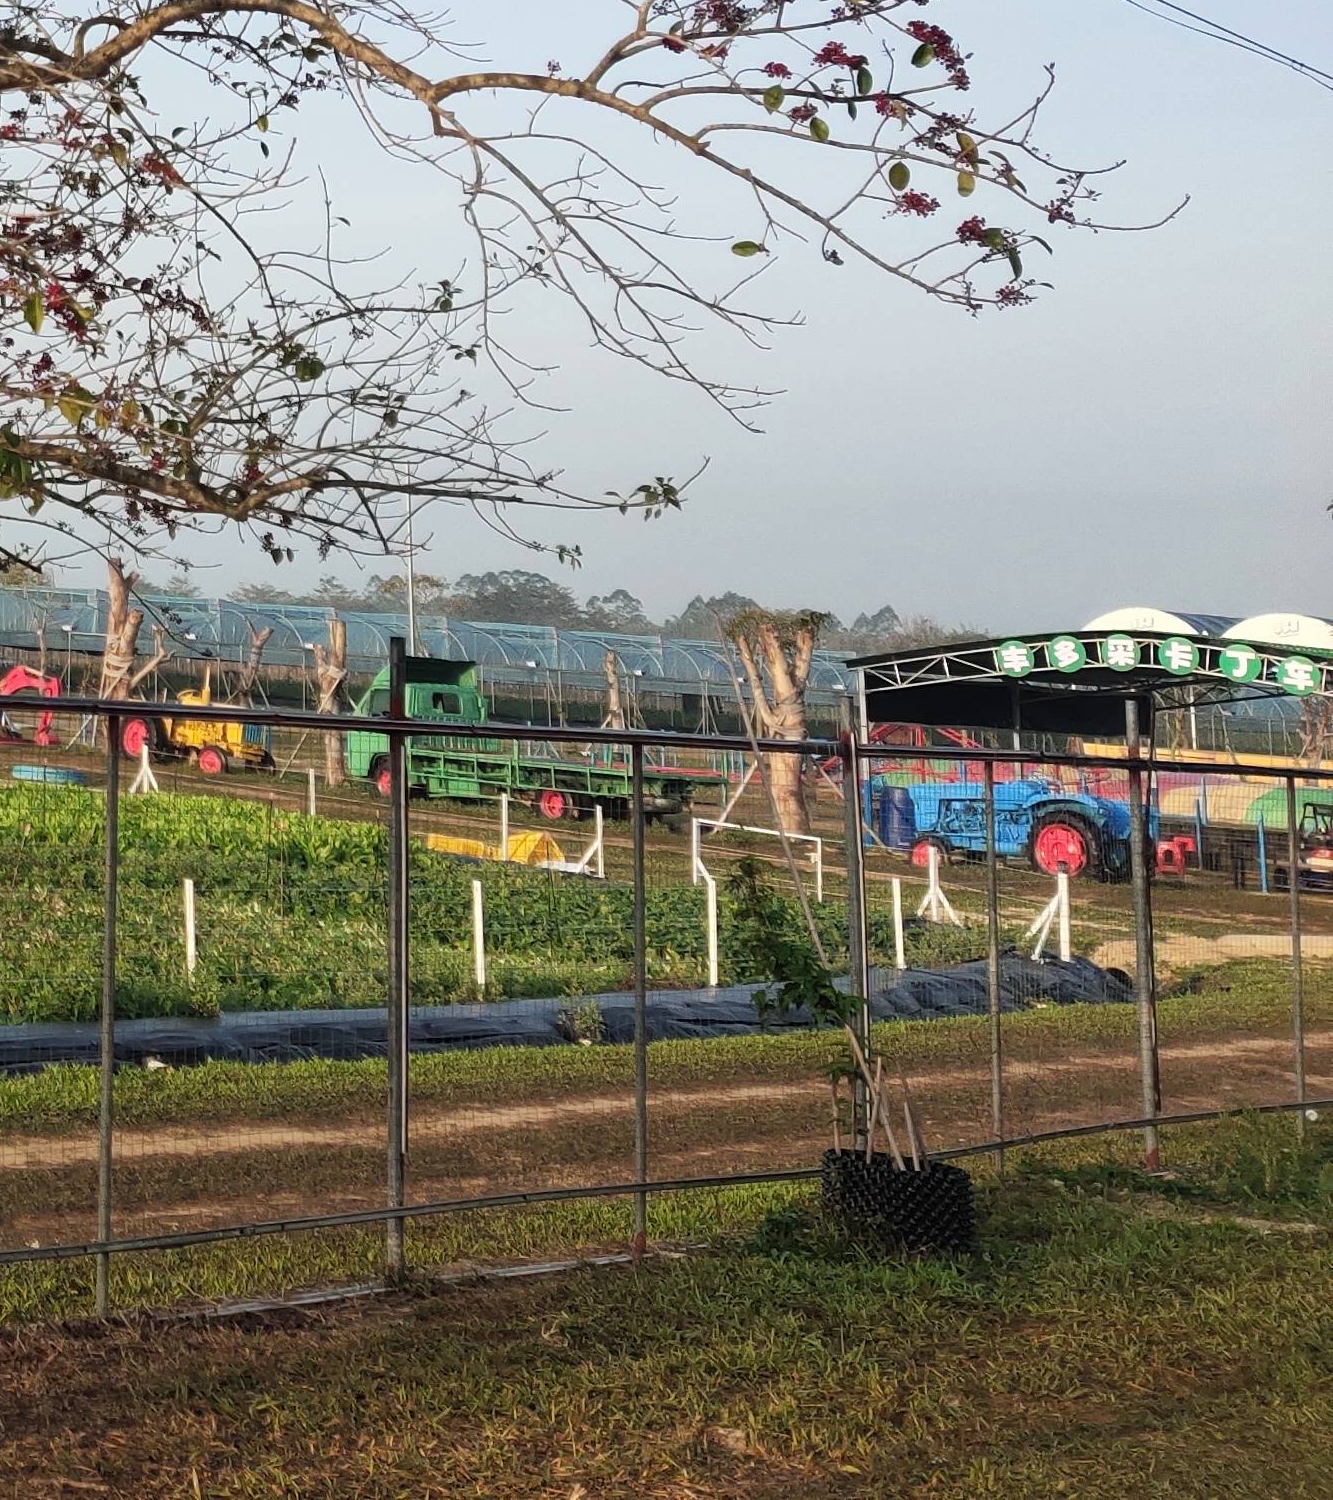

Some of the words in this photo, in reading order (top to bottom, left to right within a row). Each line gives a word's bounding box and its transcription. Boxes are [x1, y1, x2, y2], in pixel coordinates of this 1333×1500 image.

[1000, 639, 1315, 691] 丰多采卡丁车
